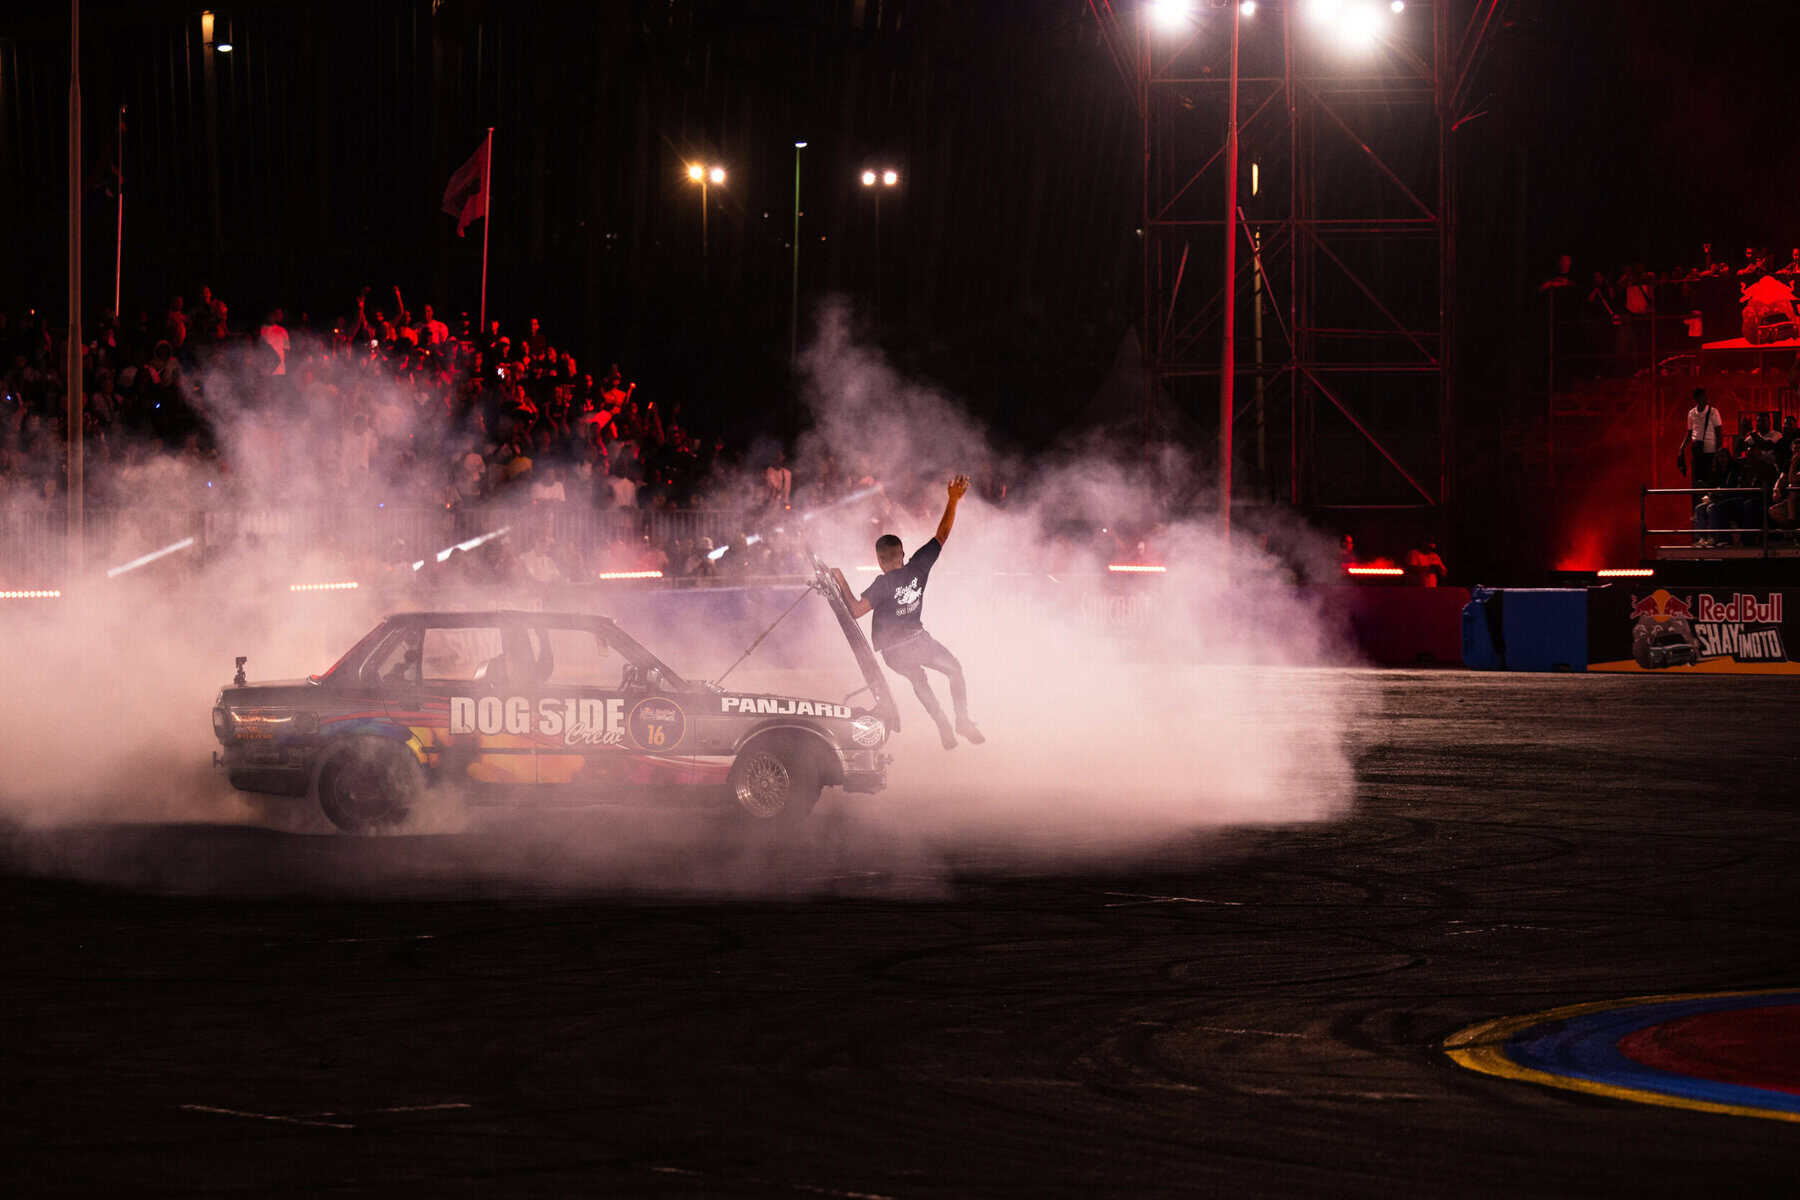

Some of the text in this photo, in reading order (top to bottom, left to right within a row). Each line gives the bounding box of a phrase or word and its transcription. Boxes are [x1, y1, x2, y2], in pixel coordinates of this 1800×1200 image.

[1698, 593, 1783, 623] Red Bull
[450, 696, 625, 736] DOG SIDE
[721, 697, 852, 719] PANJARD
[647, 724, 665, 746] 16
